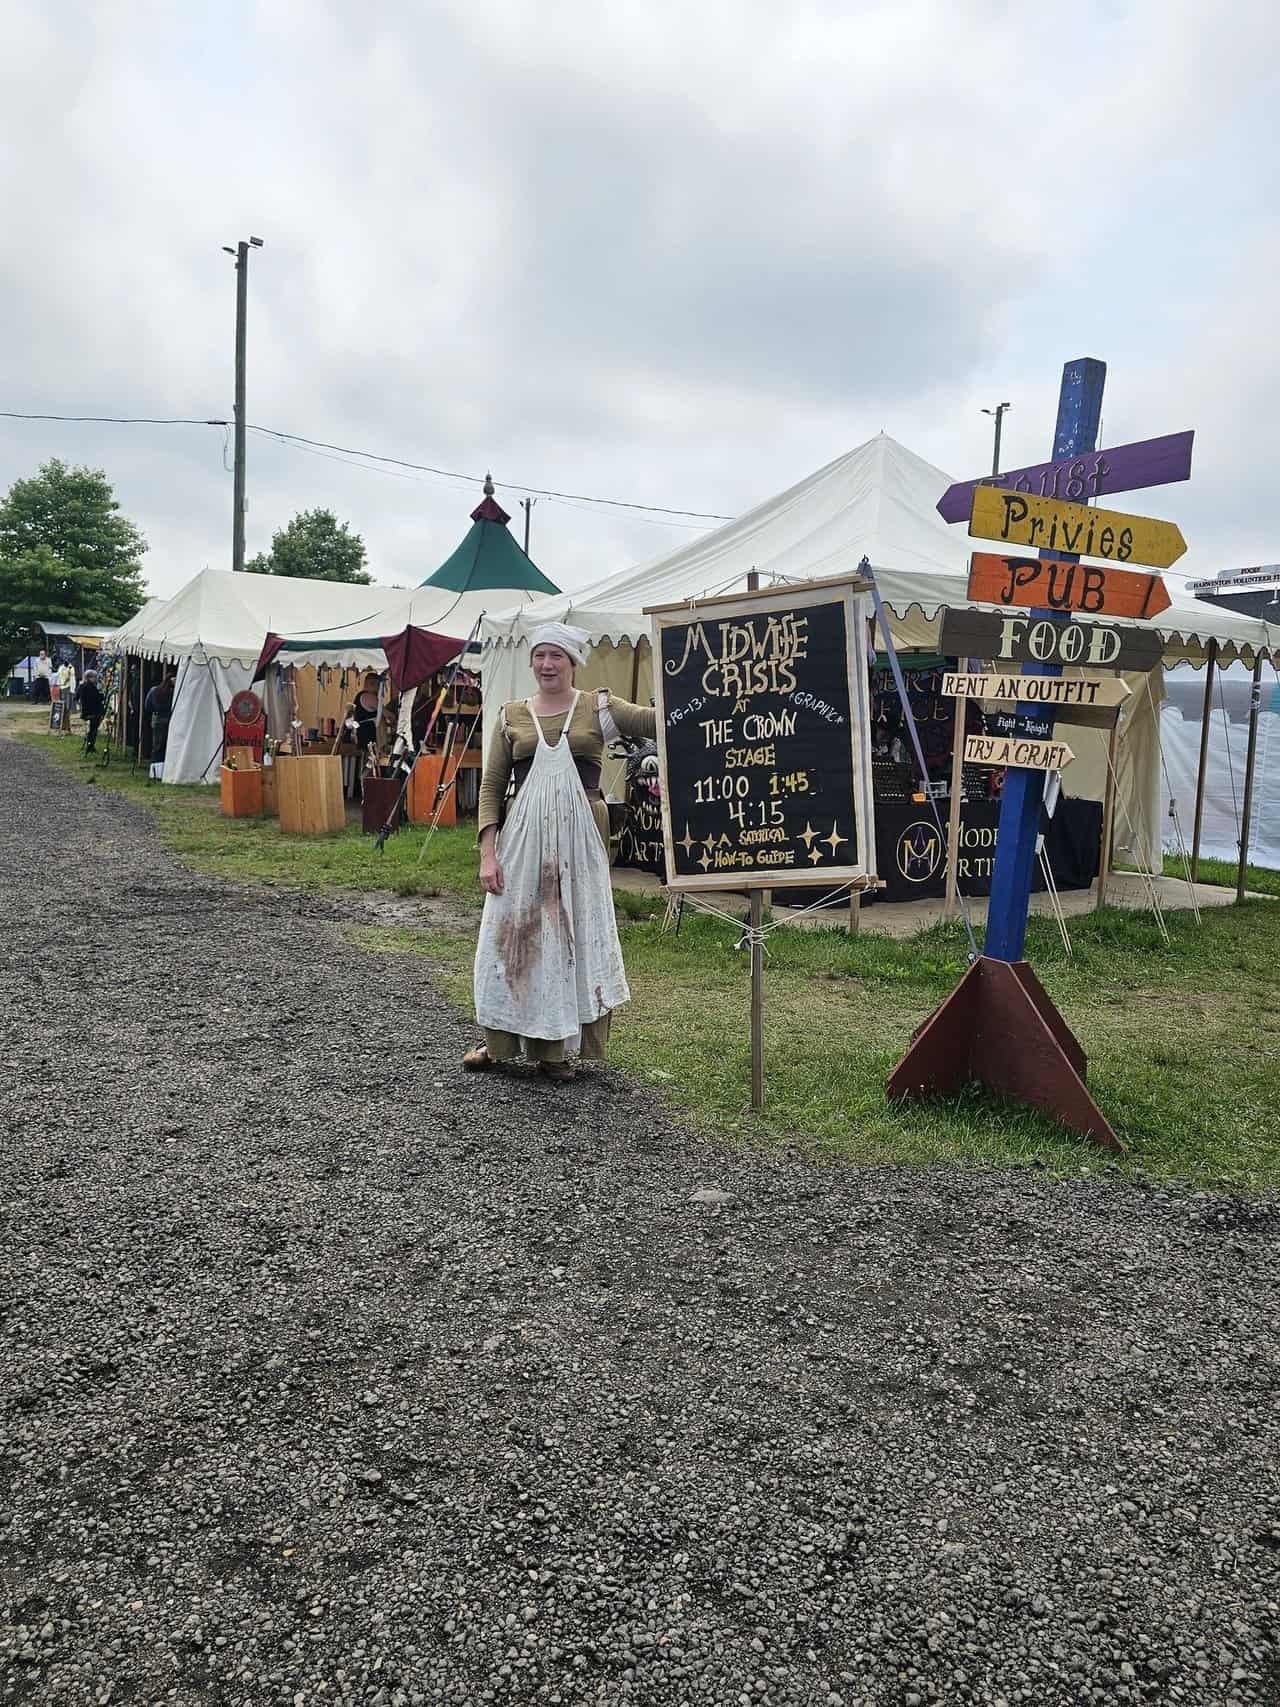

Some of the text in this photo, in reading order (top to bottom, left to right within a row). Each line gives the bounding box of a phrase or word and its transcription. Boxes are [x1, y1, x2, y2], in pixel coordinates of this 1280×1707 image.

[1001, 495, 1134, 561] Privies
[1001, 557, 1106, 613] PUB
[665, 613, 808, 676] MIDWIFE
[998, 617, 1122, 664] FOOD
[702, 658, 797, 699] CRISIS
[944, 676, 1101, 704] RENT AN OUTFIT
[732, 698, 750, 715] AT
[699, 709, 798, 748] THE CROWN
[725, 744, 775, 768] STAGE
[967, 739, 1067, 768] TRY A CRAFT
[694, 772, 809, 803] 11:00 1:45
[728, 800, 785, 828] 4:15
[716, 833, 732, 849] A
[757, 849, 795, 866] GUIDE
